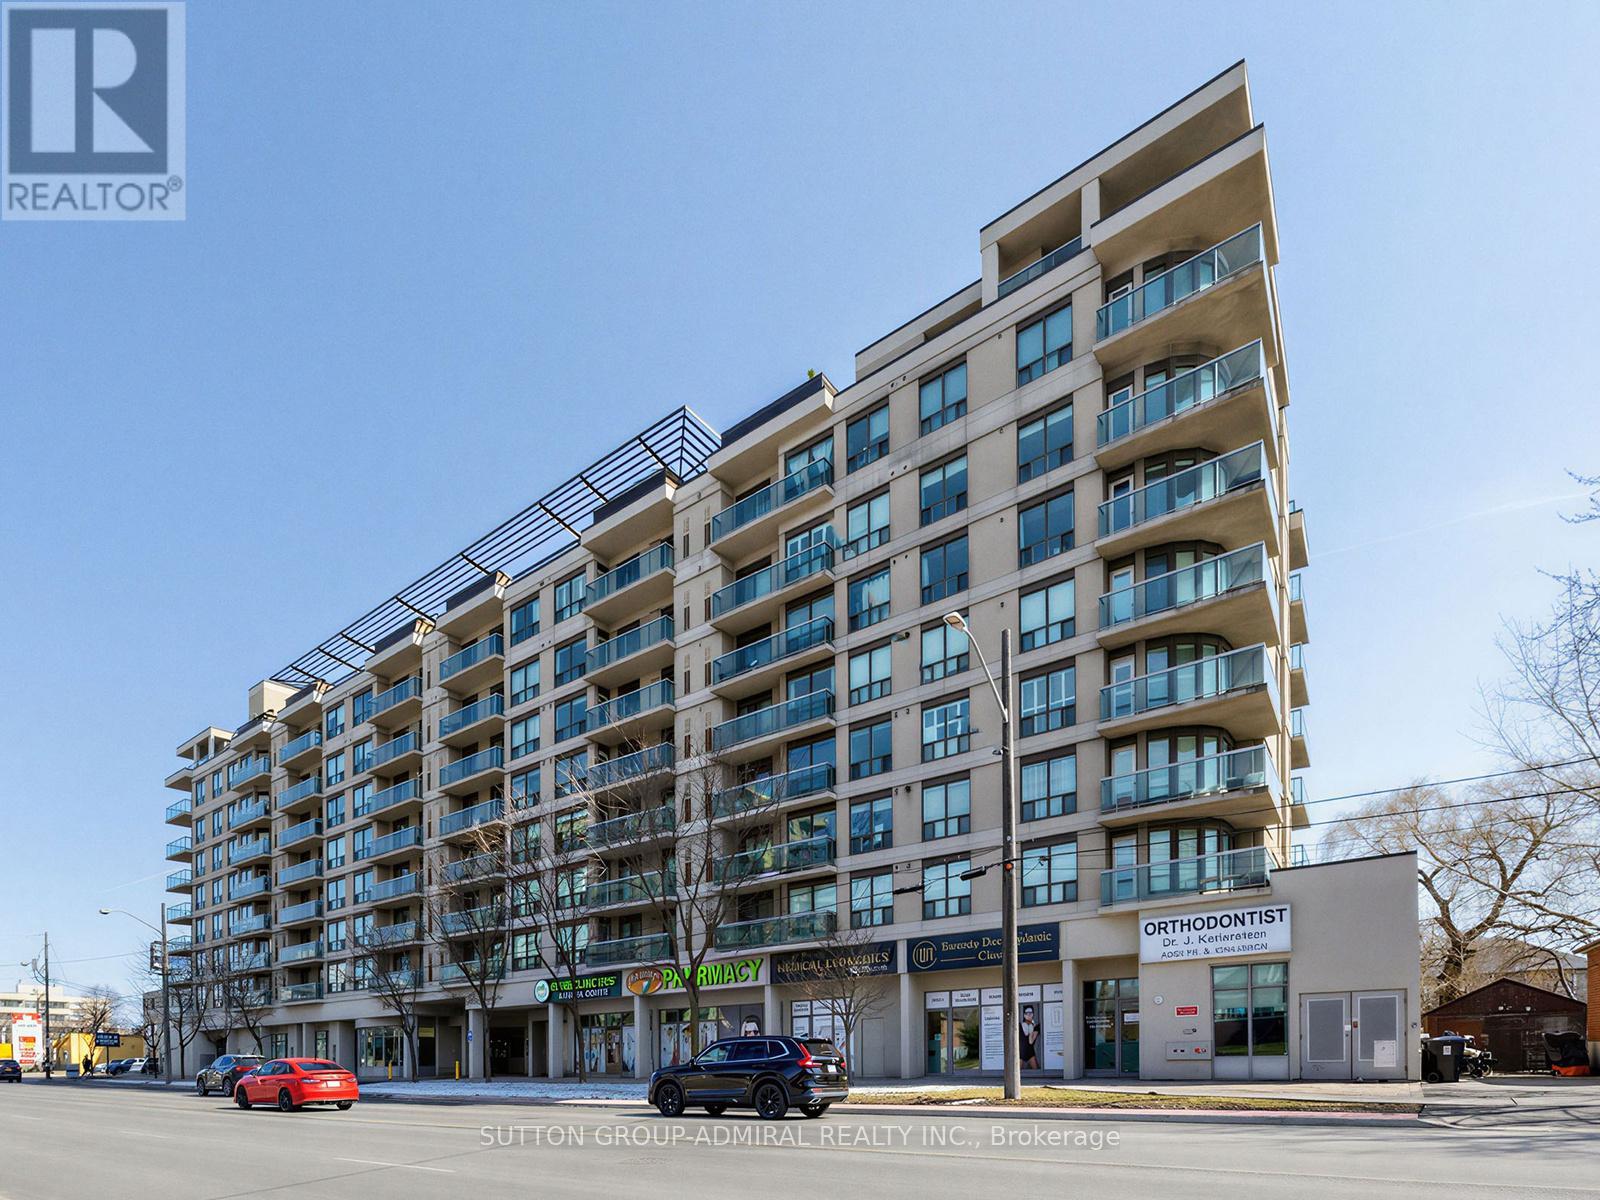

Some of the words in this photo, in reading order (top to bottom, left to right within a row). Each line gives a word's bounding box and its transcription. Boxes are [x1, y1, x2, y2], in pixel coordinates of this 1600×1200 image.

[1144, 908, 1288, 936] ORTHODONTIST
[1163, 937, 1178, 948] Dr.
[1183, 935, 1194, 946] J.
[662, 958, 763, 990] PRMACY
